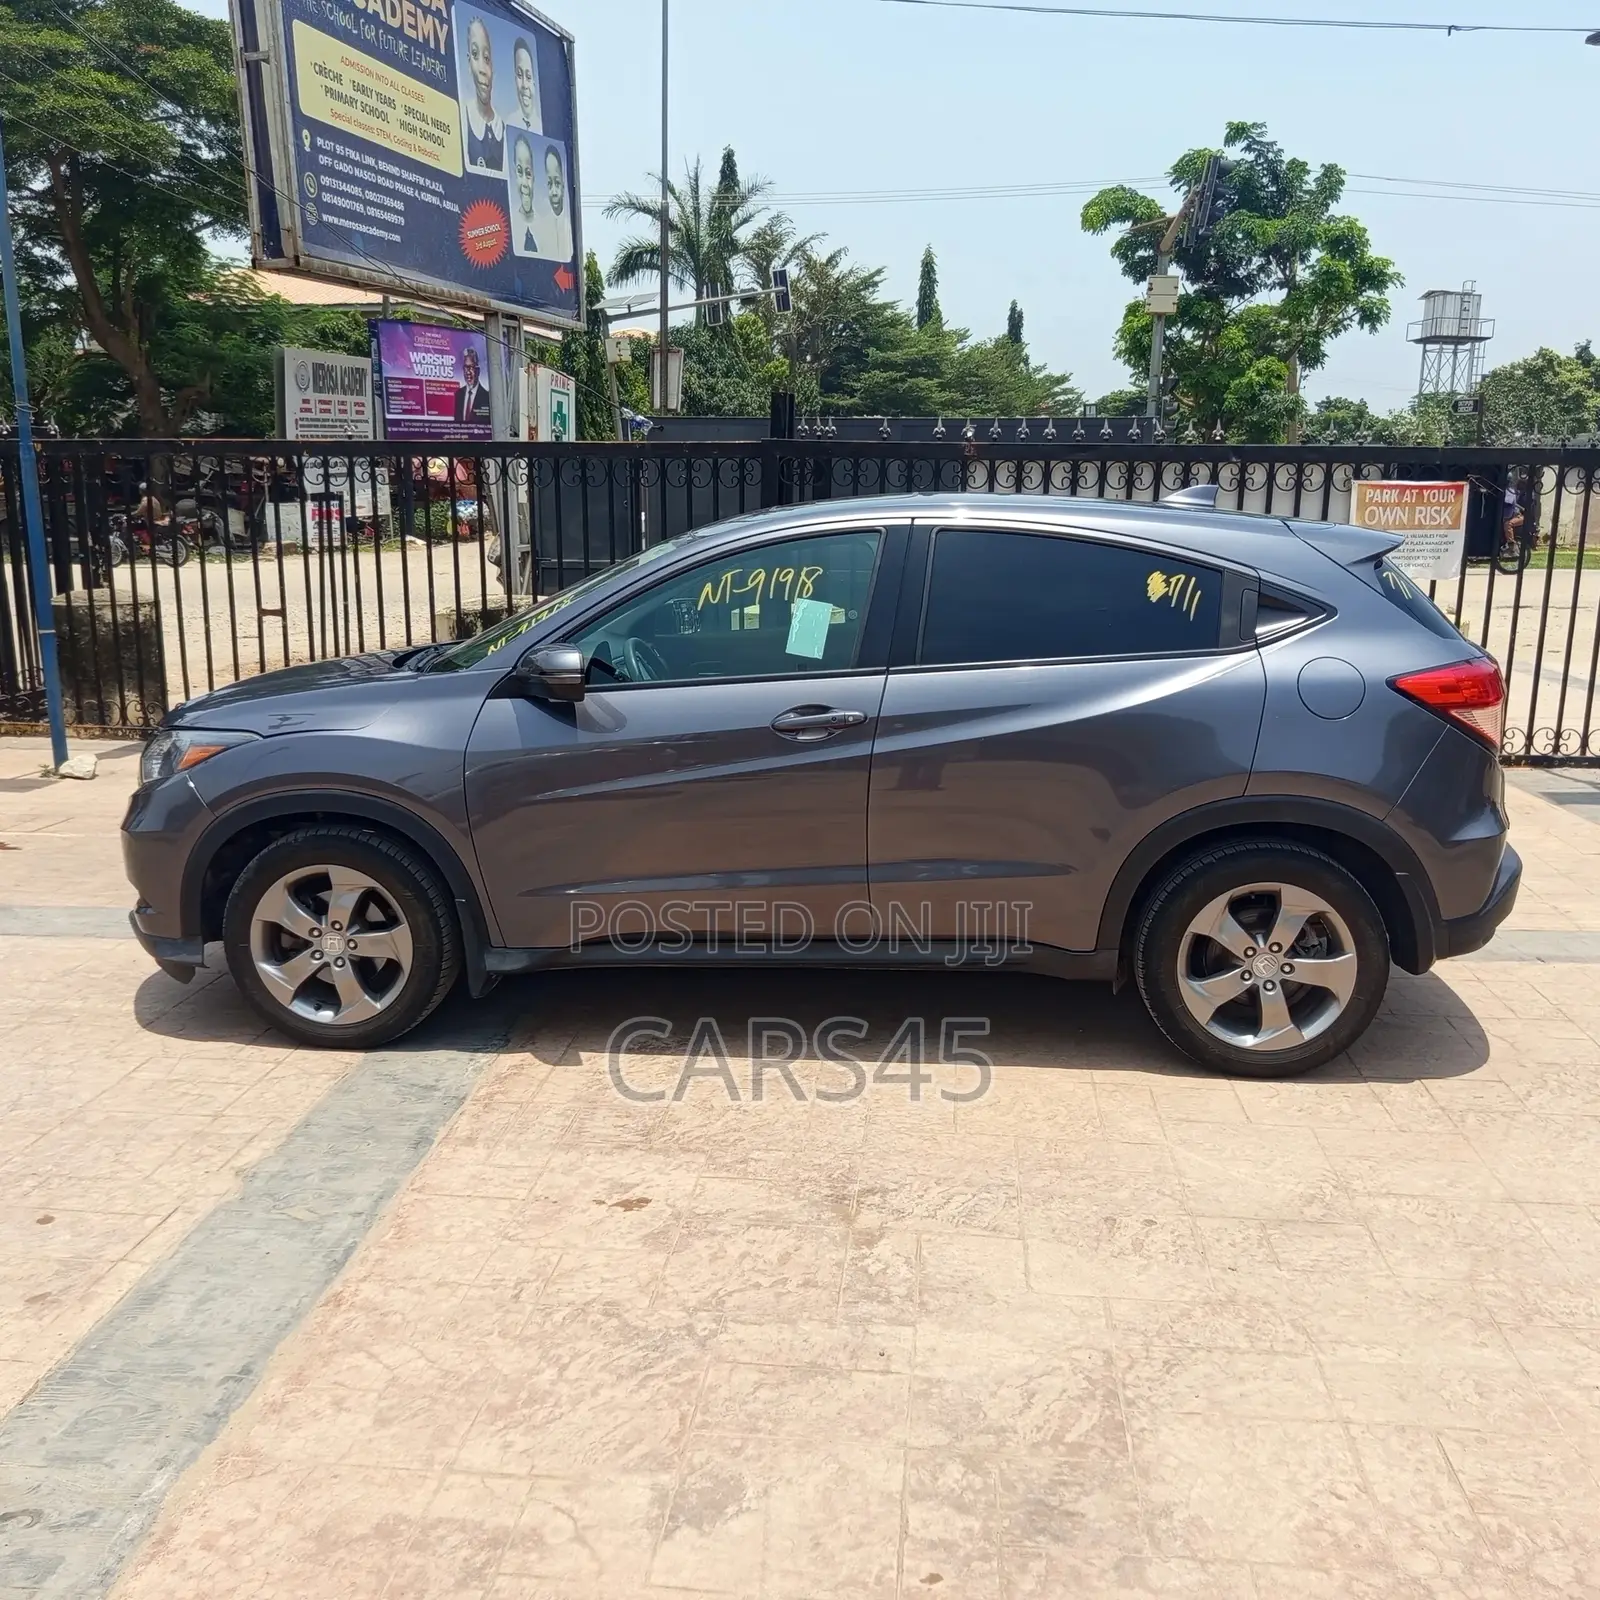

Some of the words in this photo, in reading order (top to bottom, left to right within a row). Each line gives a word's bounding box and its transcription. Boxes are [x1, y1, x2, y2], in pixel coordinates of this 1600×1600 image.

[320, 1, 358, 34] SCHOOL
[360, 18, 378, 46] FOR
[379, 28, 409, 62] FUTURE
[411, 46, 448, 82] LEADERS!
[341, 56, 374, 80] ADMISSION
[375, 71, 390, 86] INTO
[390, 80, 400, 92] ALL
[313, 61, 343, 86] CRÈCHE
[374, 90, 397, 110] YEARS
[404, 104, 430, 126] SPECIAL
[430, 116, 451, 135] NEEDS
[330, 107, 353, 125] Special
[324, 85, 358, 110] PRIMARY
[360, 101, 390, 124] SCHOOL
[400, 119, 418, 136] HIGH
[419, 127, 446, 148] SCHOOL
[316, 136, 334, 152] PLOT
[335, 144, 344, 156] 95
[345, 147, 361, 162] FIKA
[378, 160, 400, 177] BEHIND
[318, 154, 333, 168] OFF
[333, 160, 354, 175] GADO
[354, 166, 377, 183] NASCO
[377, 175, 395, 189] ROAD
[395, 181, 414, 197] PHASE
[409, 351, 456, 366] WORSHIP
[413, 363, 440, 377] WITH
[440, 365, 454, 378] US
[1364, 488, 1400, 504] PARK
[1401, 488, 1419, 504] AT
[1422, 489, 1456, 503] YOUR
[1364, 506, 1409, 526] OWN
[1414, 506, 1453, 526] RISK
